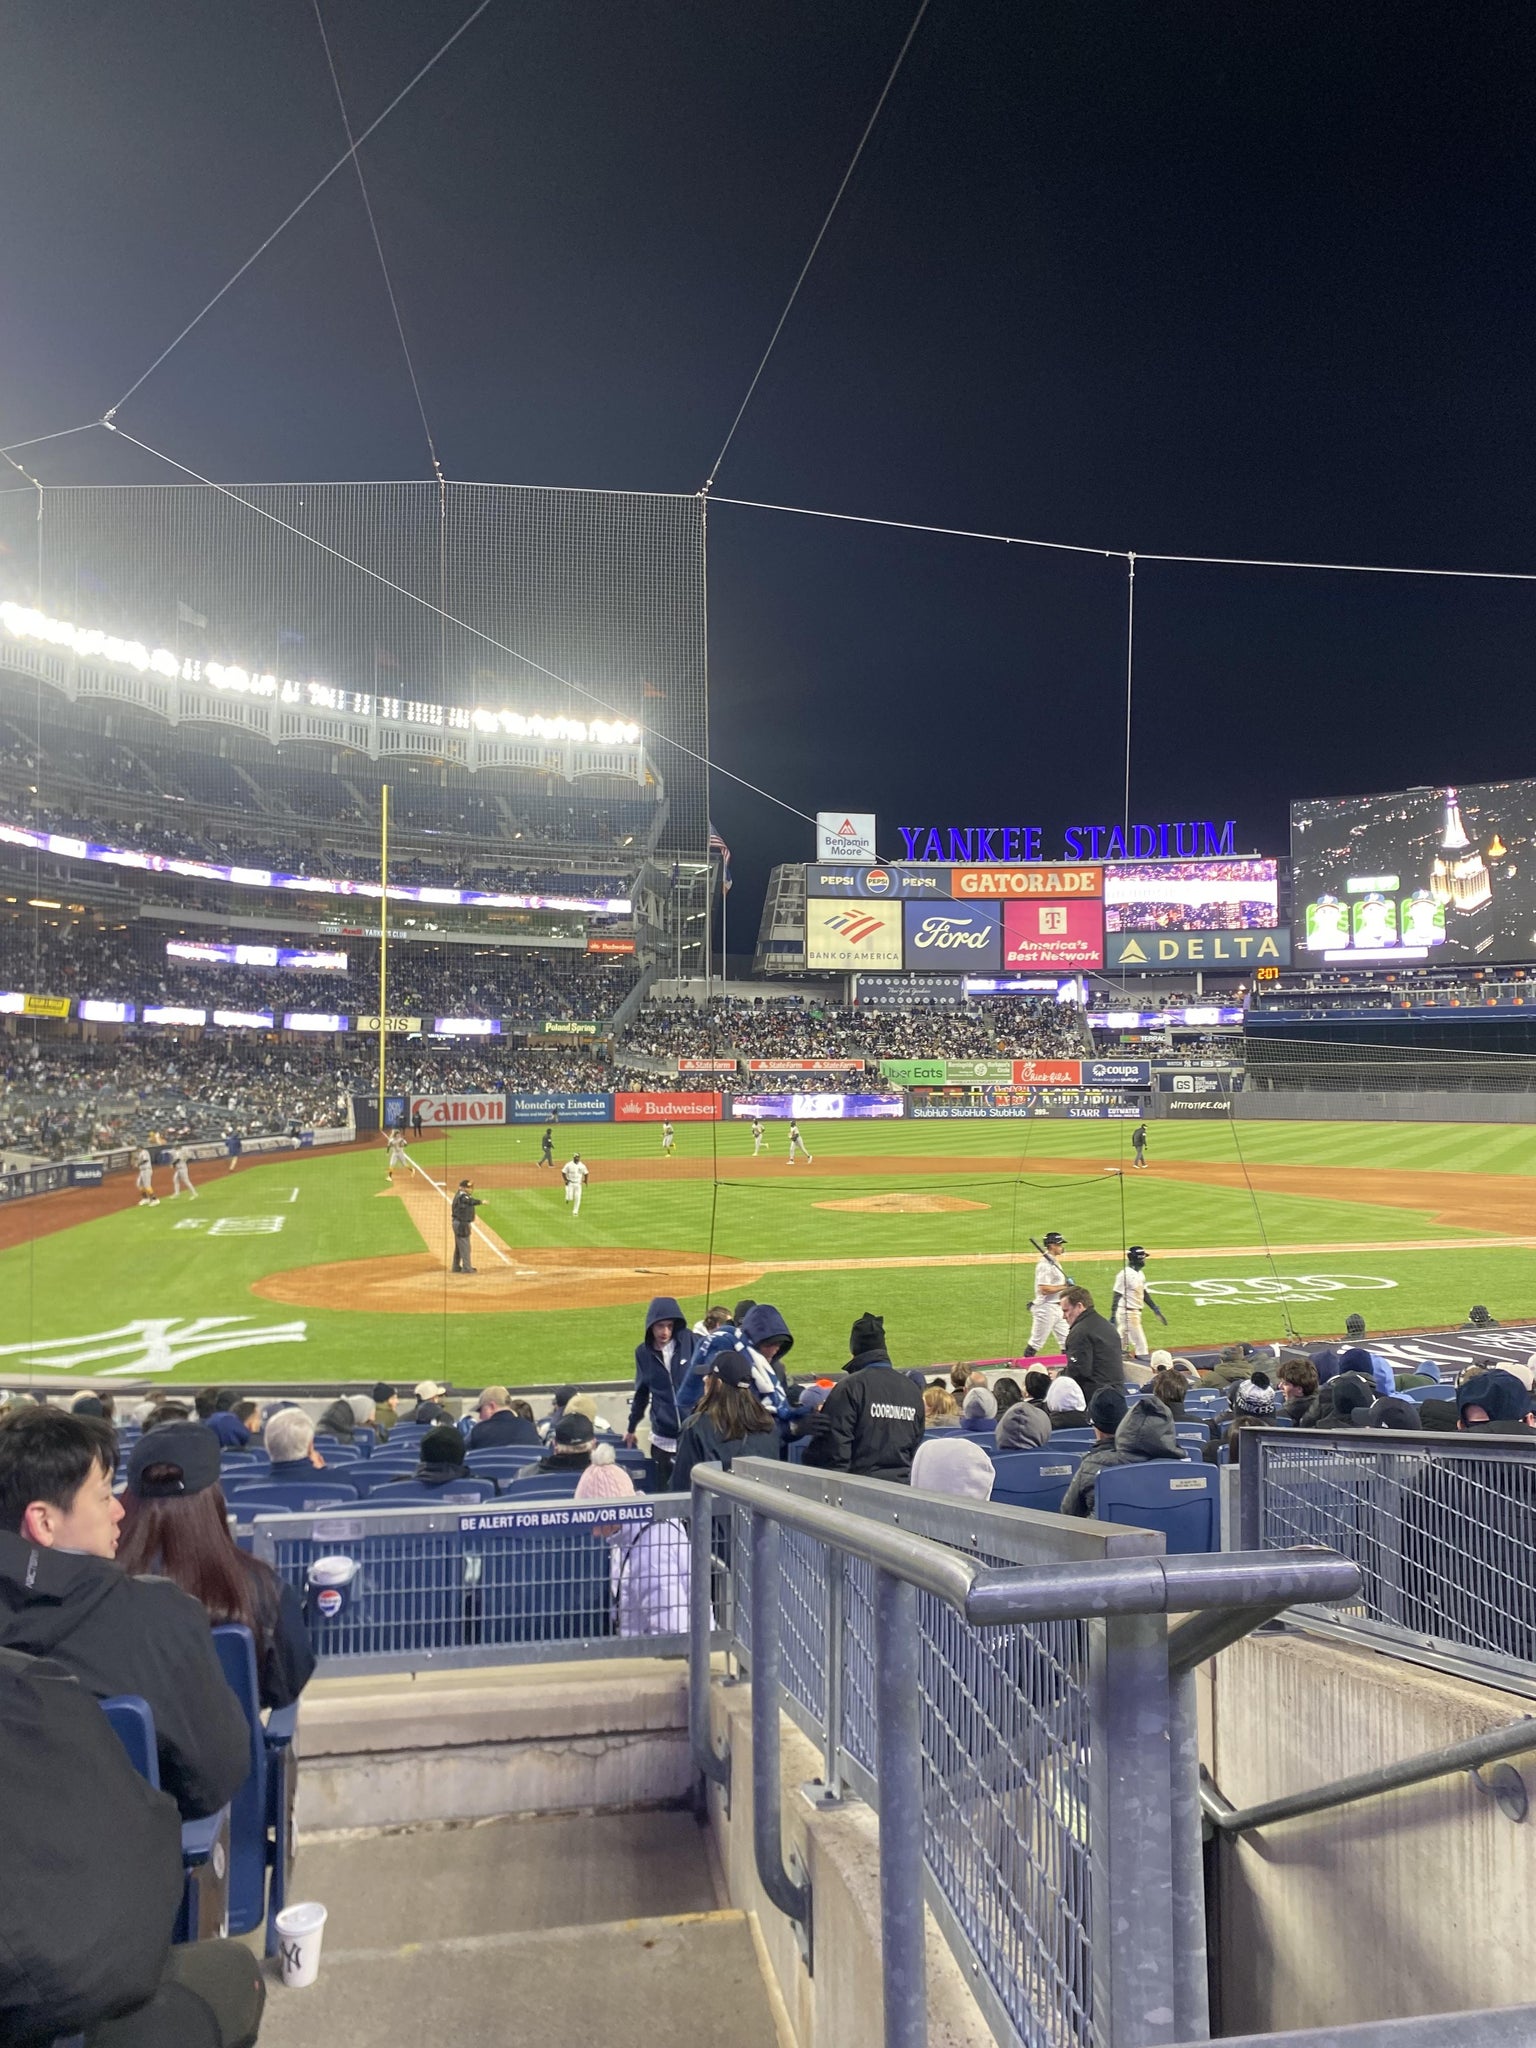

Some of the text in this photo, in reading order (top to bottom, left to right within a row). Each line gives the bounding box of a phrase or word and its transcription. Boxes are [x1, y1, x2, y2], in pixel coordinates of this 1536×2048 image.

[825, 837, 869, 847] Benjamin
[898, 821, 1237, 862] YANKEE STADIUM
[831, 846, 862, 856] Moore
[820, 876, 854, 885] PEPSI
[902, 878, 936, 887] PEPSI
[960, 873, 1095, 892] GATORADE
[914, 916, 992, 949] Ford
[1018, 940, 1088, 951] America's
[1159, 936, 1280, 960] DELTA
[809, 952, 899, 961] BANK OF AMERICA
[1008, 951, 1100, 962] Best Network
[369, 1017, 408, 1031] ORIS
[545, 1022, 596, 1034] Poland Spring
[913, 1068, 943, 1078] Eats
[1107, 1066, 1139, 1077] coupa
[1176, 1081, 1190, 1090] GS
[412, 1098, 503, 1122] Canon
[515, 1099, 606, 1110] Montefiore Einstein
[645, 1102, 716, 1114] Budweiser
[1170, 1101, 1230, 1110] NITTOTIRE.COM
[913, 1108, 1026, 1117] StubHub StubHub StubHub
[1069, 1109, 1100, 1117] STARR
[1194, 1293, 1337, 1306] Audi
[870, 1403, 916, 1421] COORDINATOR
[461, 1507, 653, 1531] BE ALERT FOR BATS AND/OR BALLS
